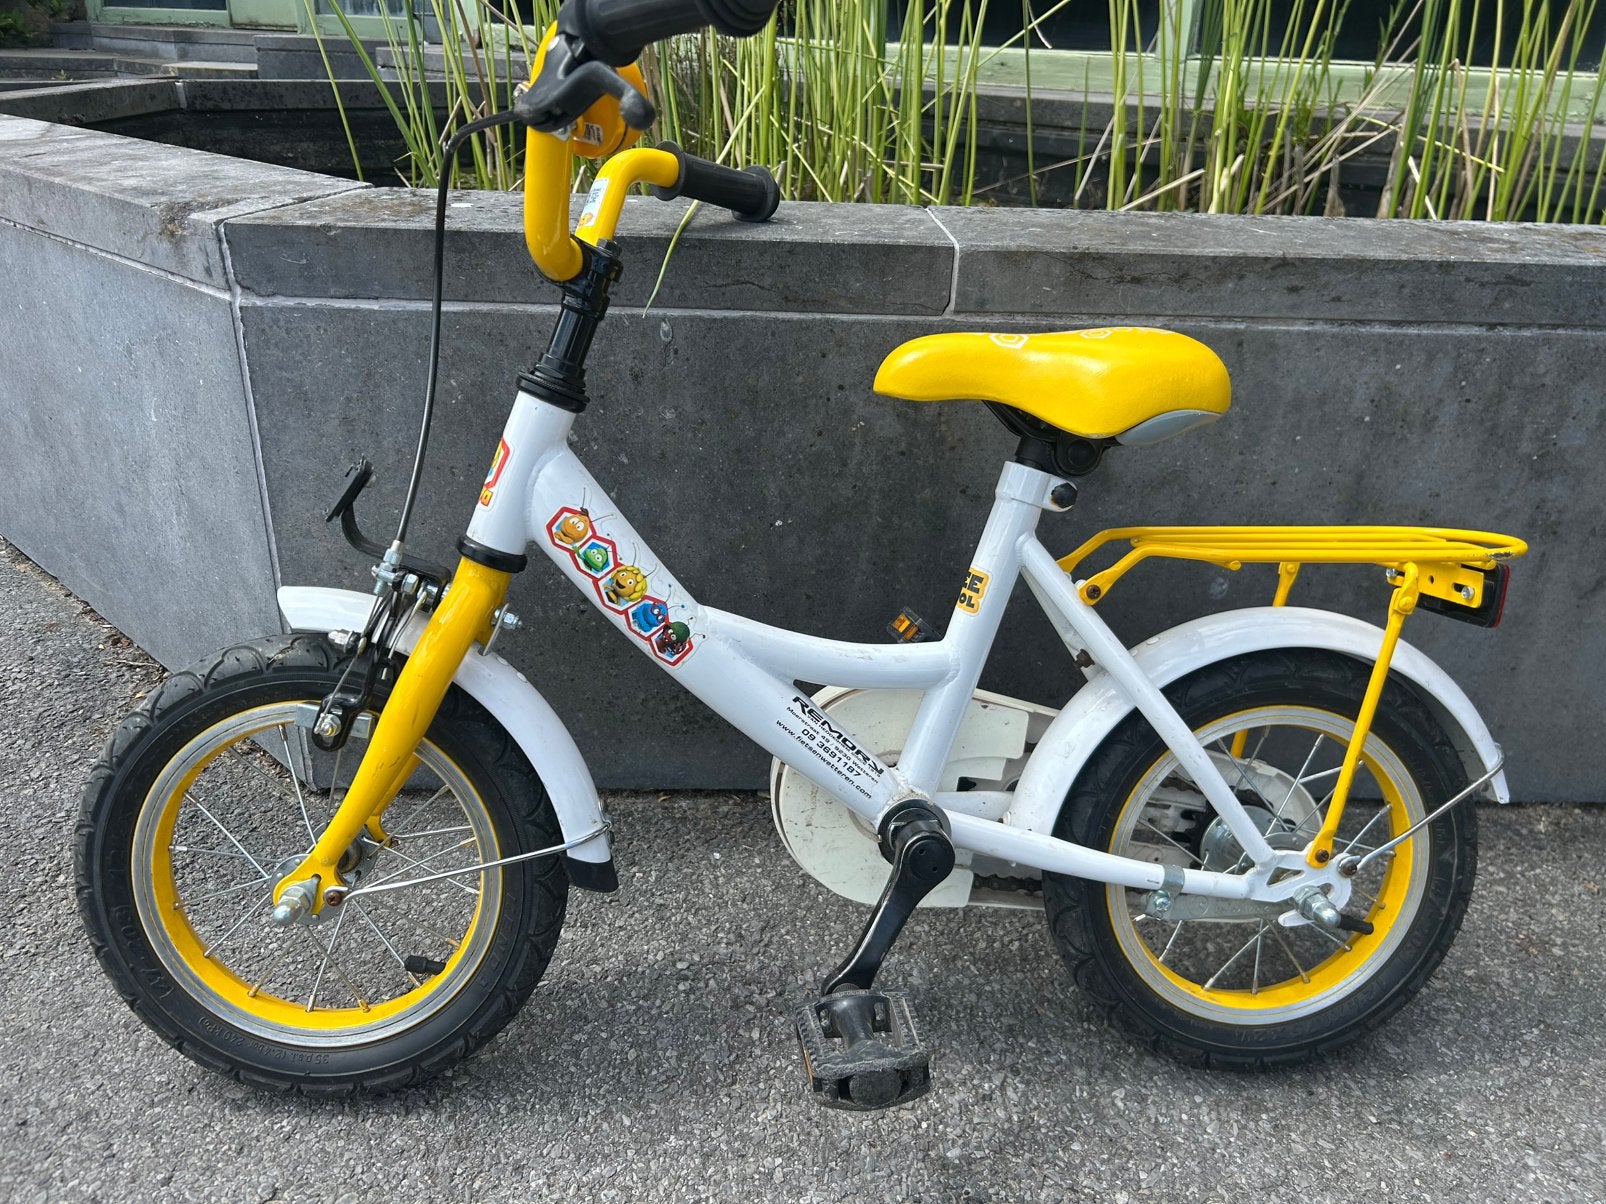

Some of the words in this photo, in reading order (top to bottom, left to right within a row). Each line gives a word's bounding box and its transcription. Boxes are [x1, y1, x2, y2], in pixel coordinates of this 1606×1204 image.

[776, 720, 872, 799] www.fietsenwetteren.com
[792, 696, 884, 774] REMORY
[801, 728, 816, 741] 09
[816, 741, 861, 776] 3691187
[852, 760, 879, 784] Wetteren
